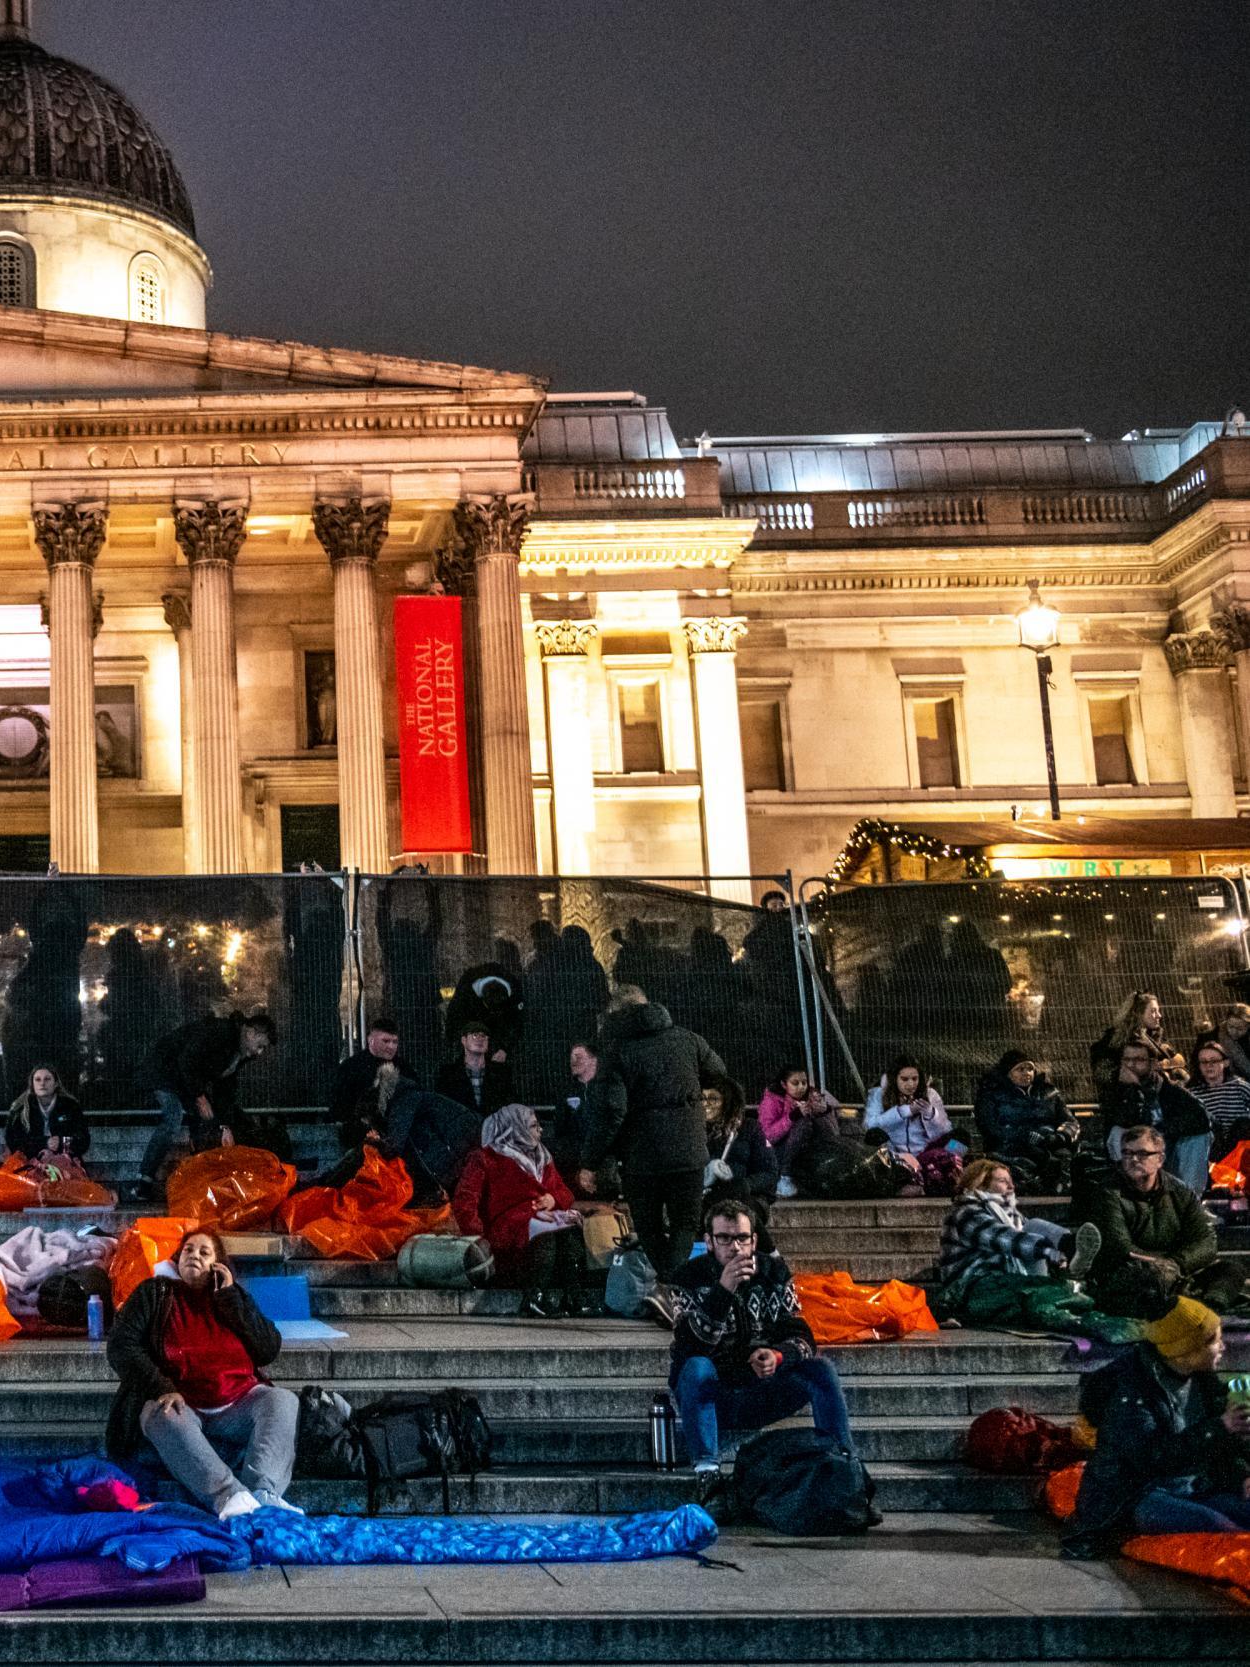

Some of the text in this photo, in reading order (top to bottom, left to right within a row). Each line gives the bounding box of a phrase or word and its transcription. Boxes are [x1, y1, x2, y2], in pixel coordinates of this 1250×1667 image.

[88, 443, 291, 469] GALLERY
[407, 704, 415, 725] THE
[416, 638, 435, 756] NATIONAL
[436, 639, 458, 756] GALLERY
